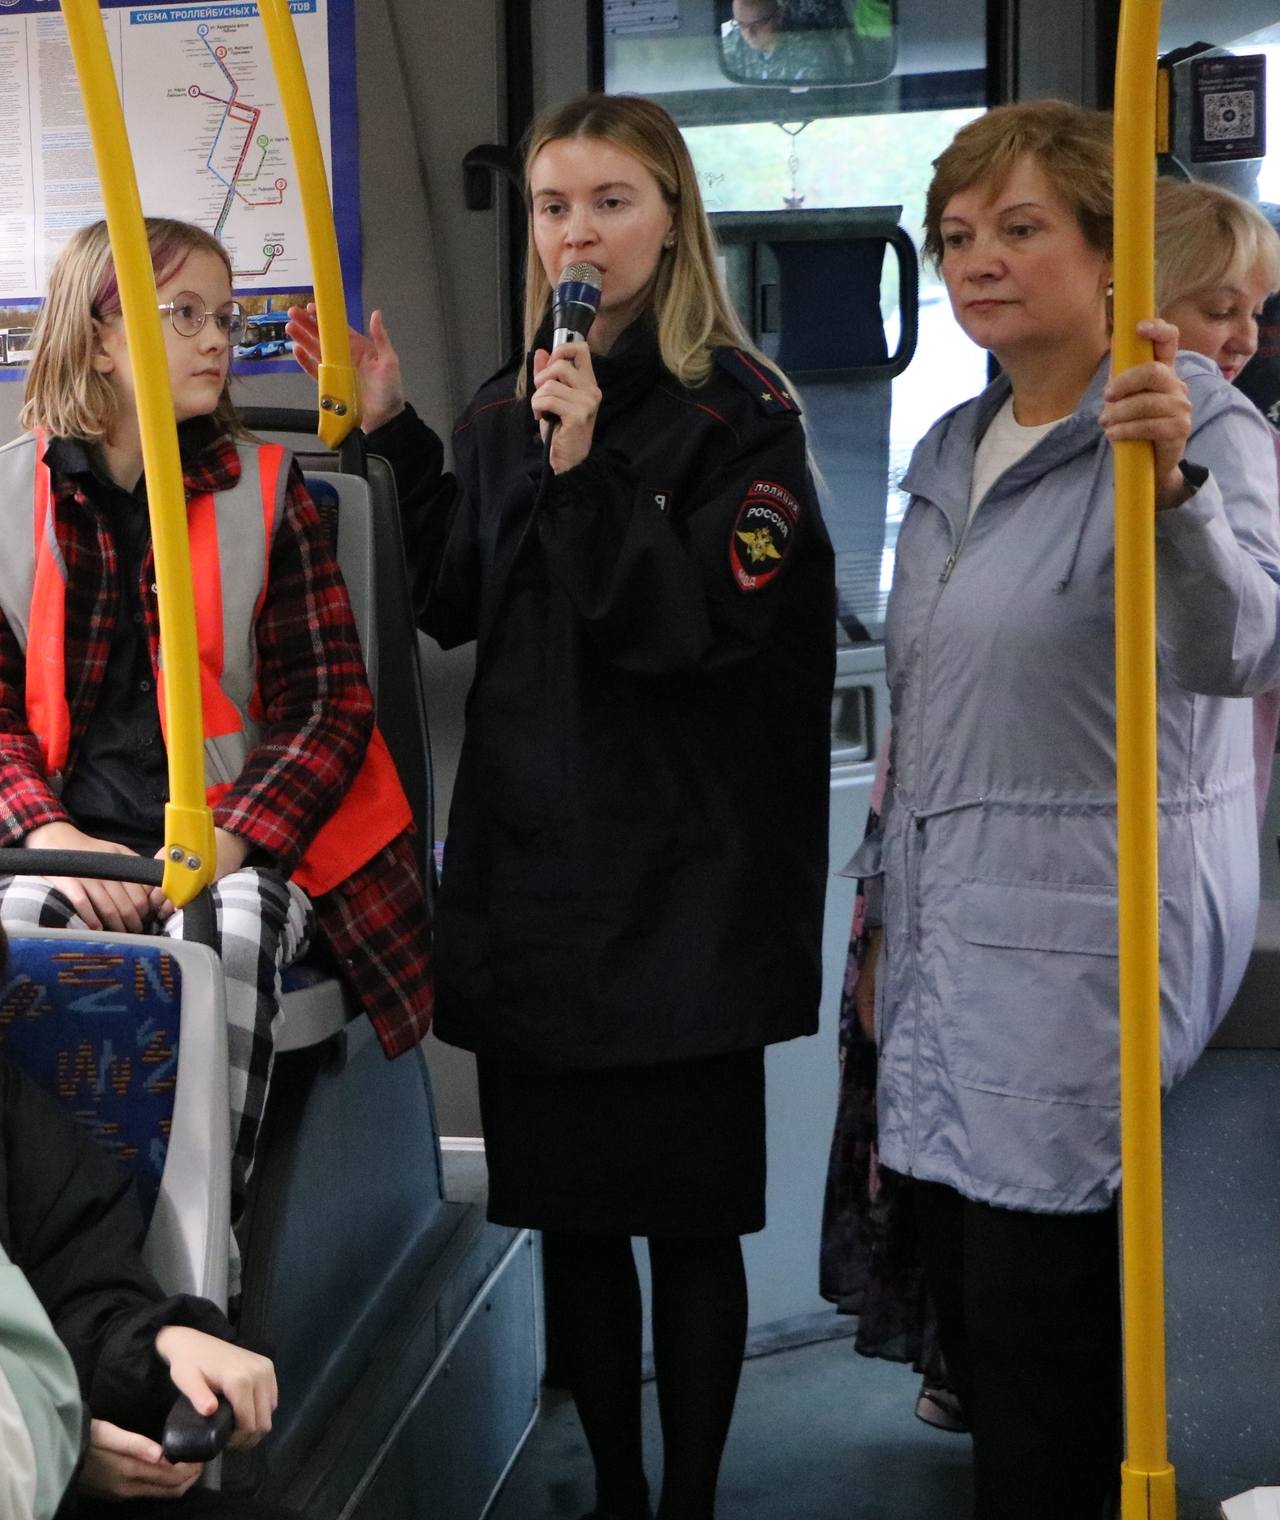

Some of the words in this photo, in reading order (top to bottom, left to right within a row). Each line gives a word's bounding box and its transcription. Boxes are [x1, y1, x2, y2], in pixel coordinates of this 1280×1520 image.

[136, 12, 168, 22] СХЕМА
[171, 7, 250, 20] ТРОЛЛЕЙБУСНЫХ
[754, 483, 799, 512] ПОЛИЦИЯ
[746, 507, 789, 538] РОССИЯ
